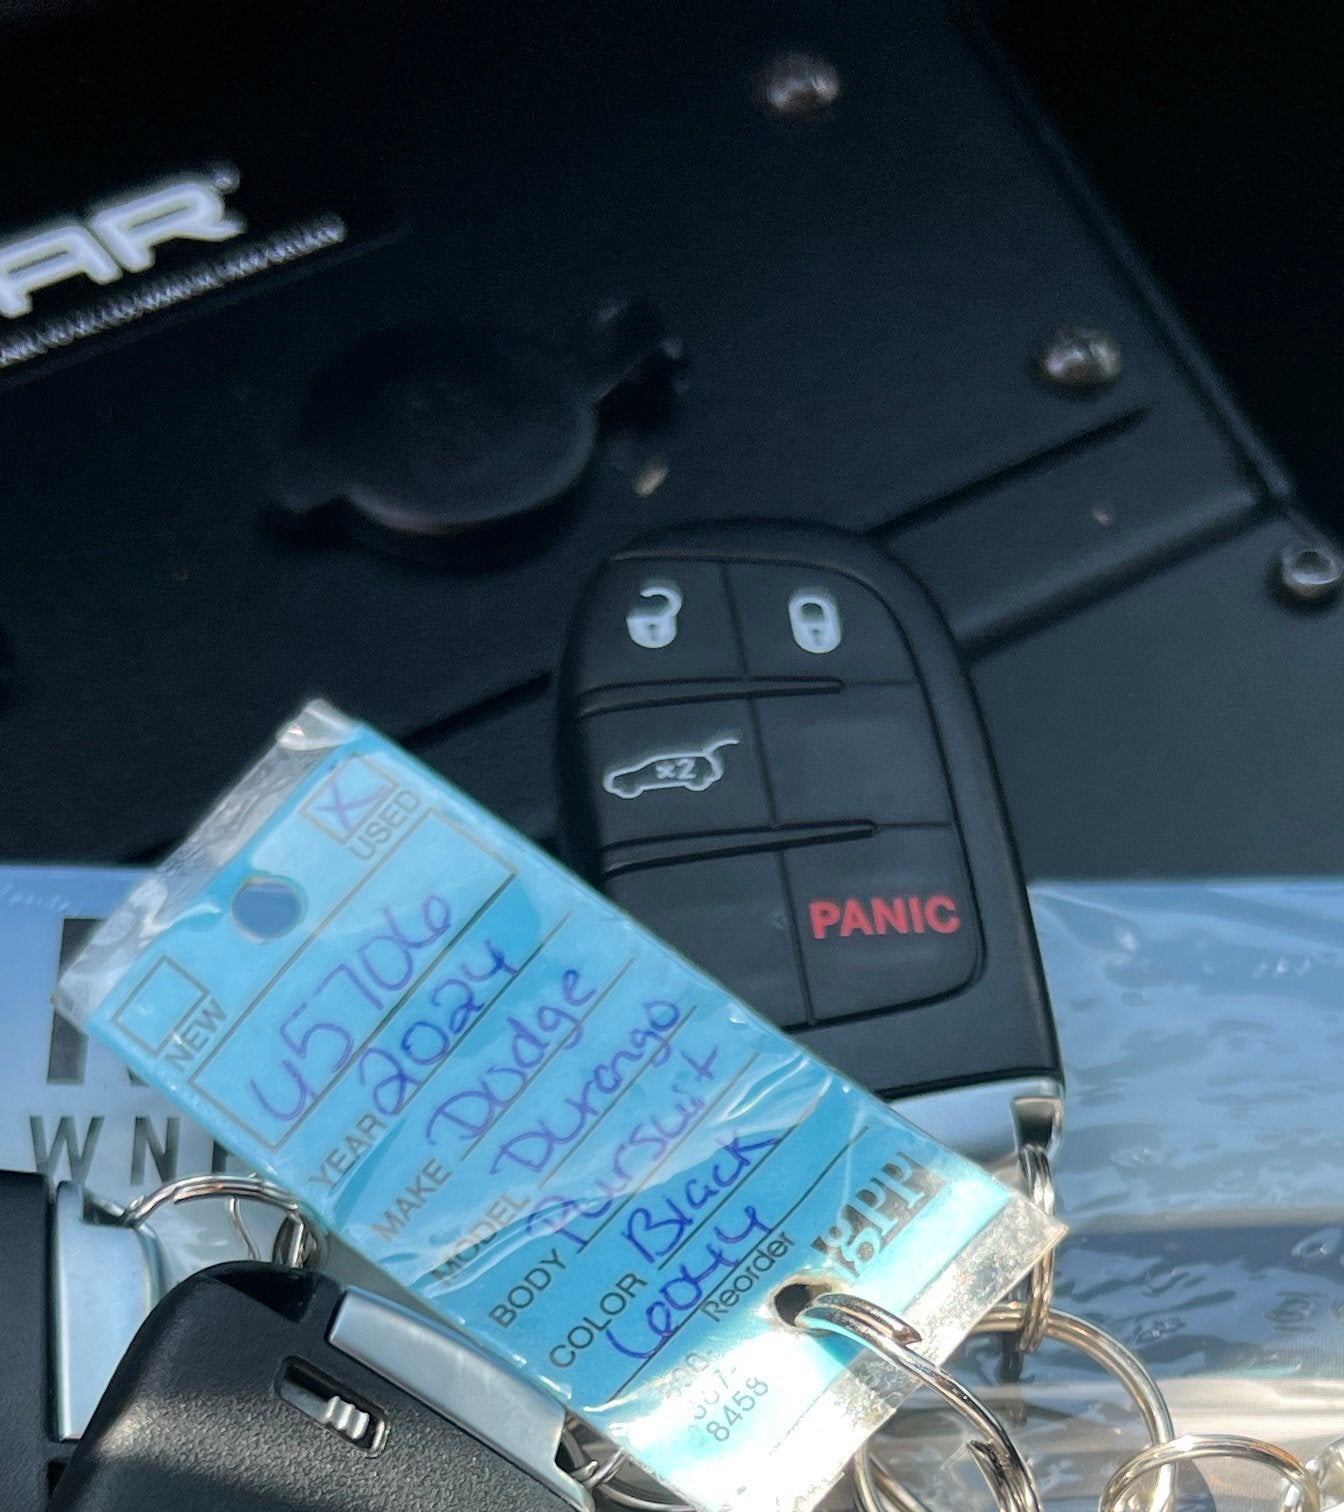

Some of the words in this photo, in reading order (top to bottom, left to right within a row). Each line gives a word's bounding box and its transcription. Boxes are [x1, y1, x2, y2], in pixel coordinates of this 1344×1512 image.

[350, 789, 419, 863] USED
[809, 896, 961, 939] PANIC
[168, 1001, 229, 1072] NEW
[358, 938, 518, 1115] 2024
[425, 963, 597, 1148] Dodge
[492, 999, 682, 1175] Durango
[310, 1112, 386, 1193] YEAR
[530, 1044, 719, 1250] Pursuit
[372, 1161, 449, 1241] MAKE
[430, 1193, 533, 1287] MODEL
[622, 1134, 782, 1264] Black
[488, 1245, 565, 1329] BODY
[550, 1273, 649, 1368] COLOR
[701, 1230, 793, 1324] Reorder
[704, 1374, 770, 1444] 8458
